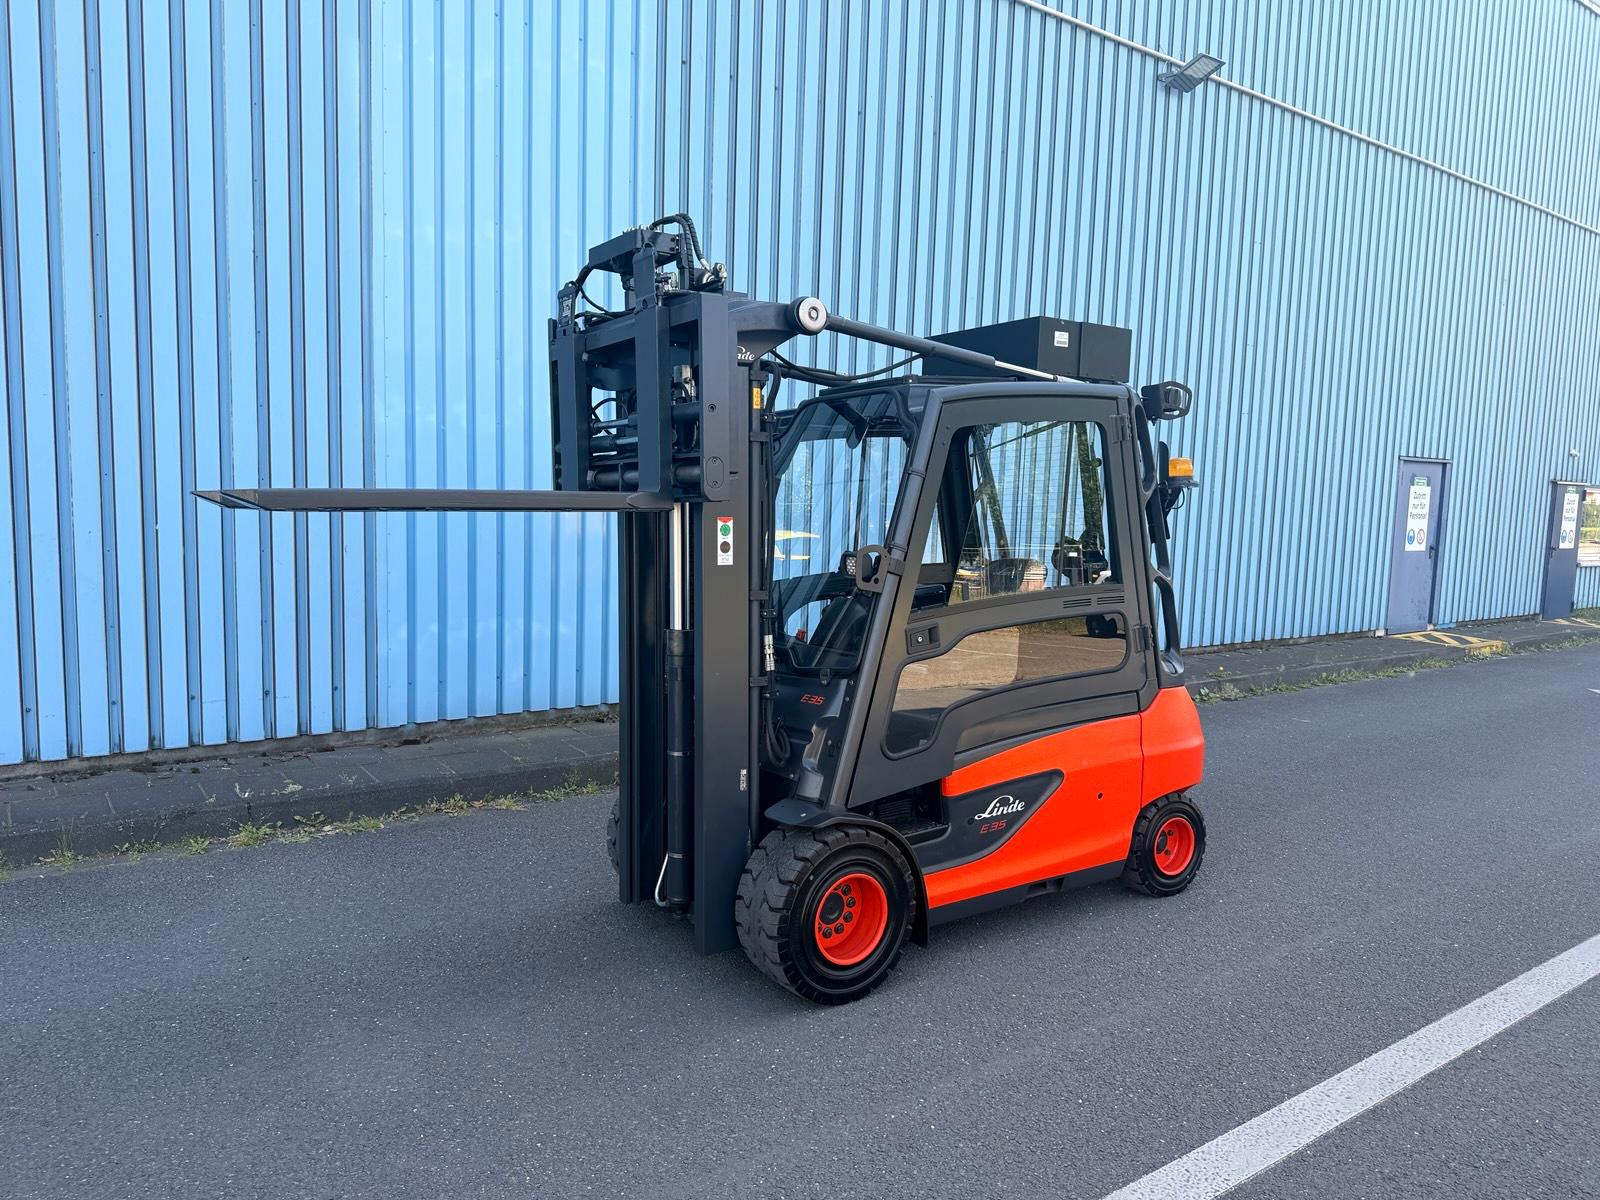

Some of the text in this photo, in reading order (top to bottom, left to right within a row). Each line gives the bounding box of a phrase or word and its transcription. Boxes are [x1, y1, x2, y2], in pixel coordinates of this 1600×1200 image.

[736, 345, 755, 361] nde
[800, 693, 826, 705] E35
[974, 795, 1026, 820] Linde
[980, 819, 1007, 834] E35
